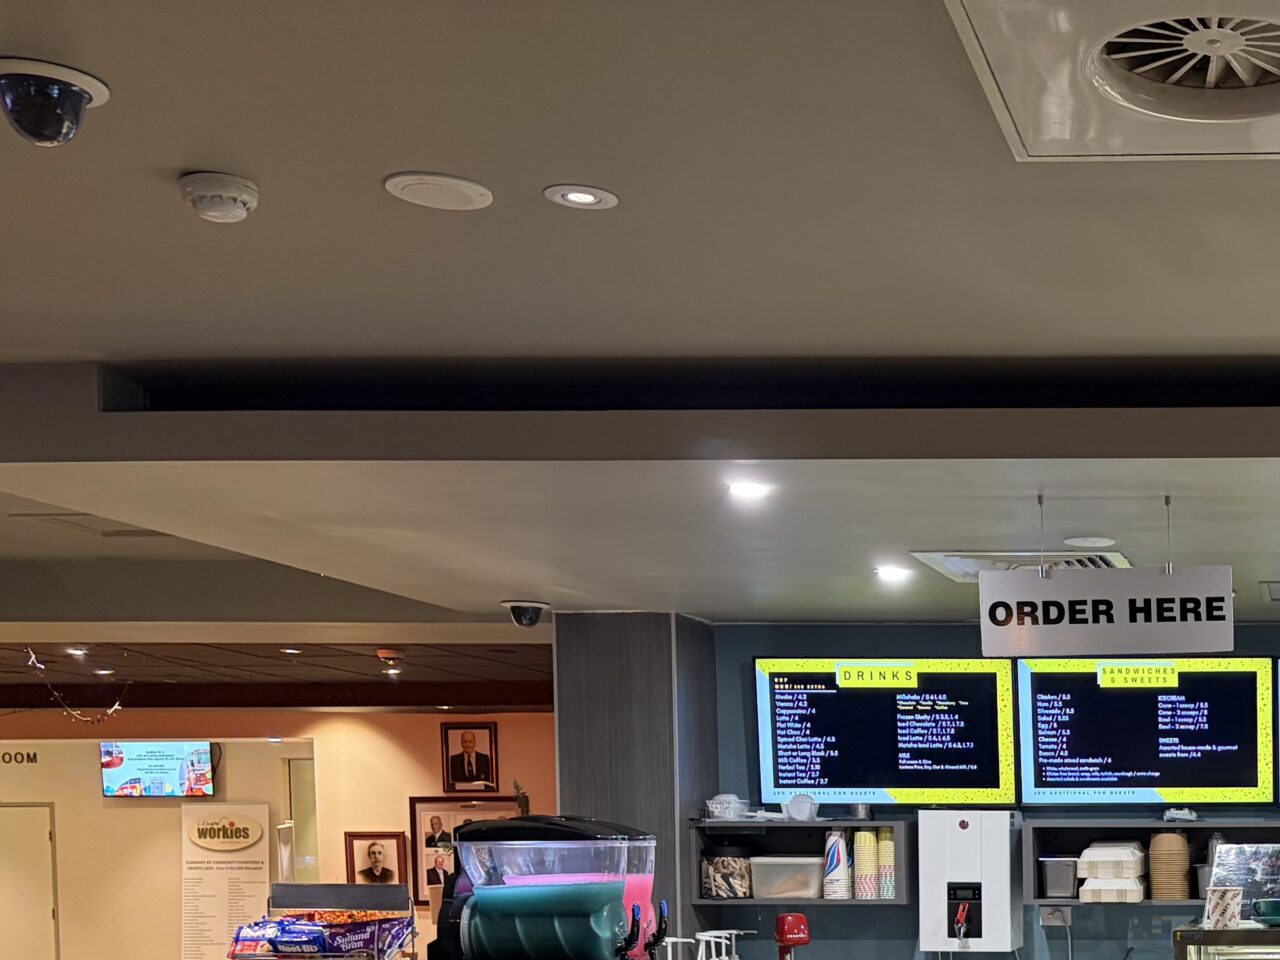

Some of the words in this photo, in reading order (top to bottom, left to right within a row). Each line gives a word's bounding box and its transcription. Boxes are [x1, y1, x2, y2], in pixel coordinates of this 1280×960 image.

[988, 598, 1115, 627] ORDER
[1128, 596, 1226, 623] HERE
[844, 671, 912, 680] DRINKS
[2, 753, 38, 764] OOM
[197, 821, 250, 839] workies
